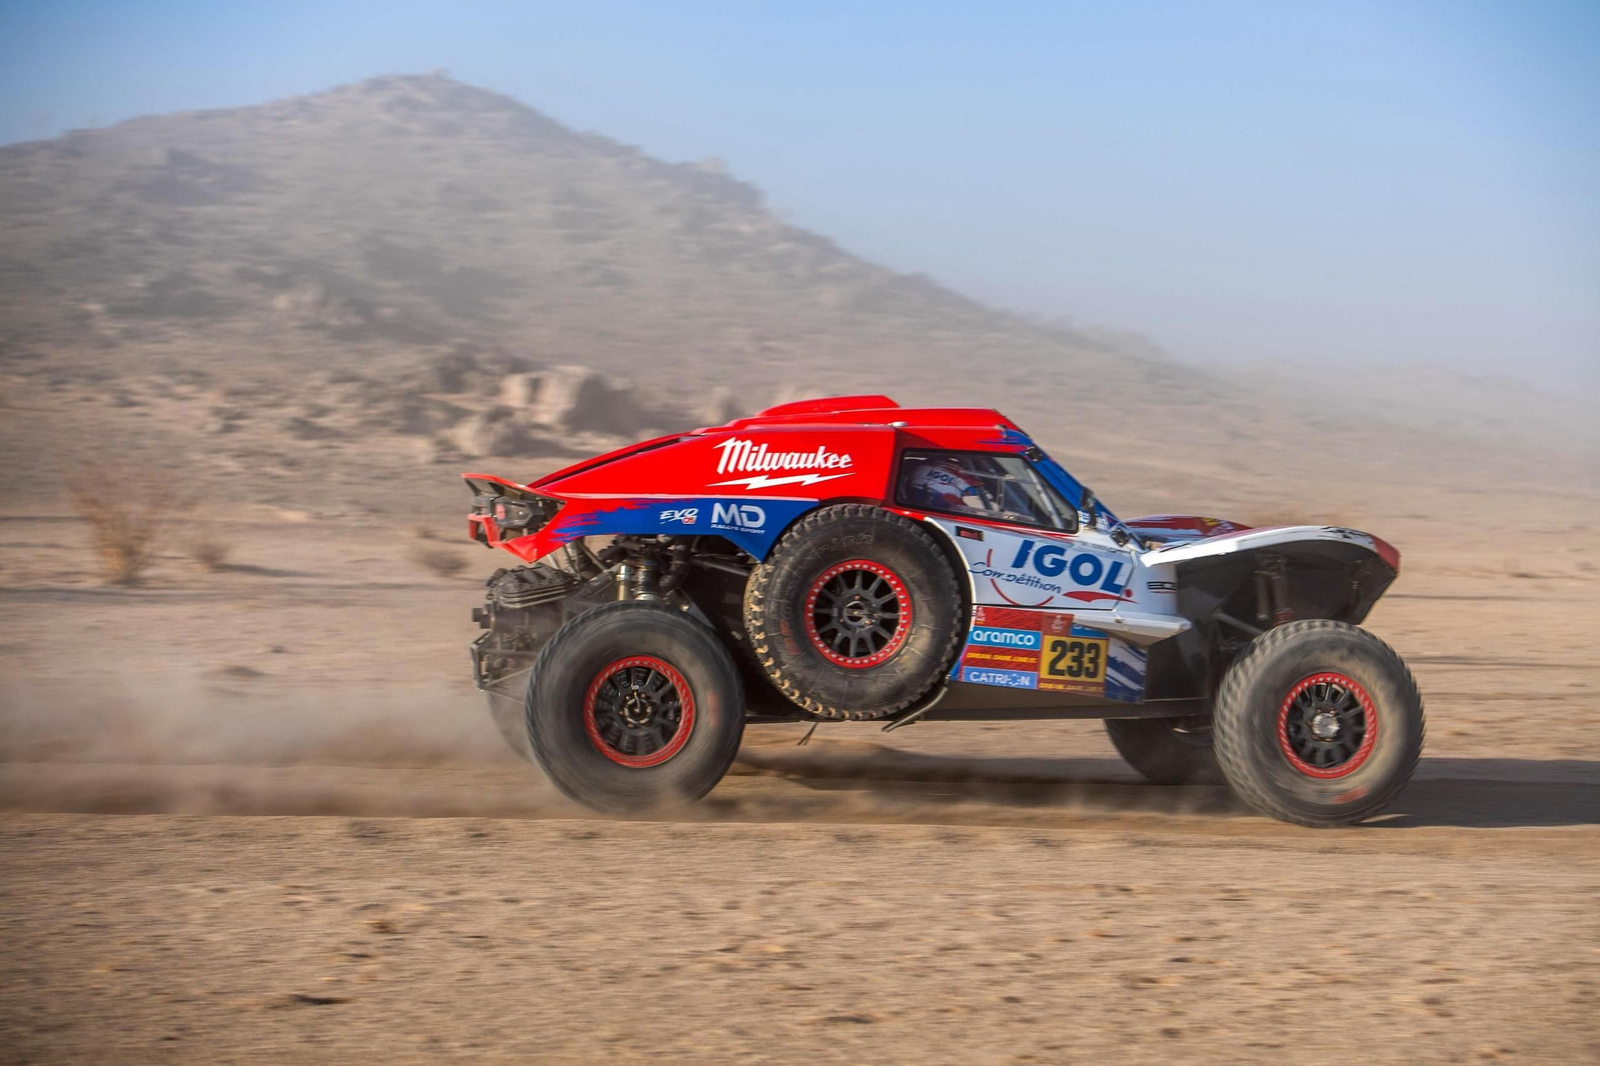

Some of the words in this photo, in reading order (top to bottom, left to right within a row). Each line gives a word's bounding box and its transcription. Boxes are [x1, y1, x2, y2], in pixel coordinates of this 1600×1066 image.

[712, 437, 853, 474] Milwaukee
[926, 470, 954, 484] IGOL
[660, 508, 698, 520] EVO
[711, 503, 766, 528] MD
[1011, 539, 1124, 594] IGOL
[972, 630, 1035, 646] aramco
[1048, 640, 1100, 678] 233
